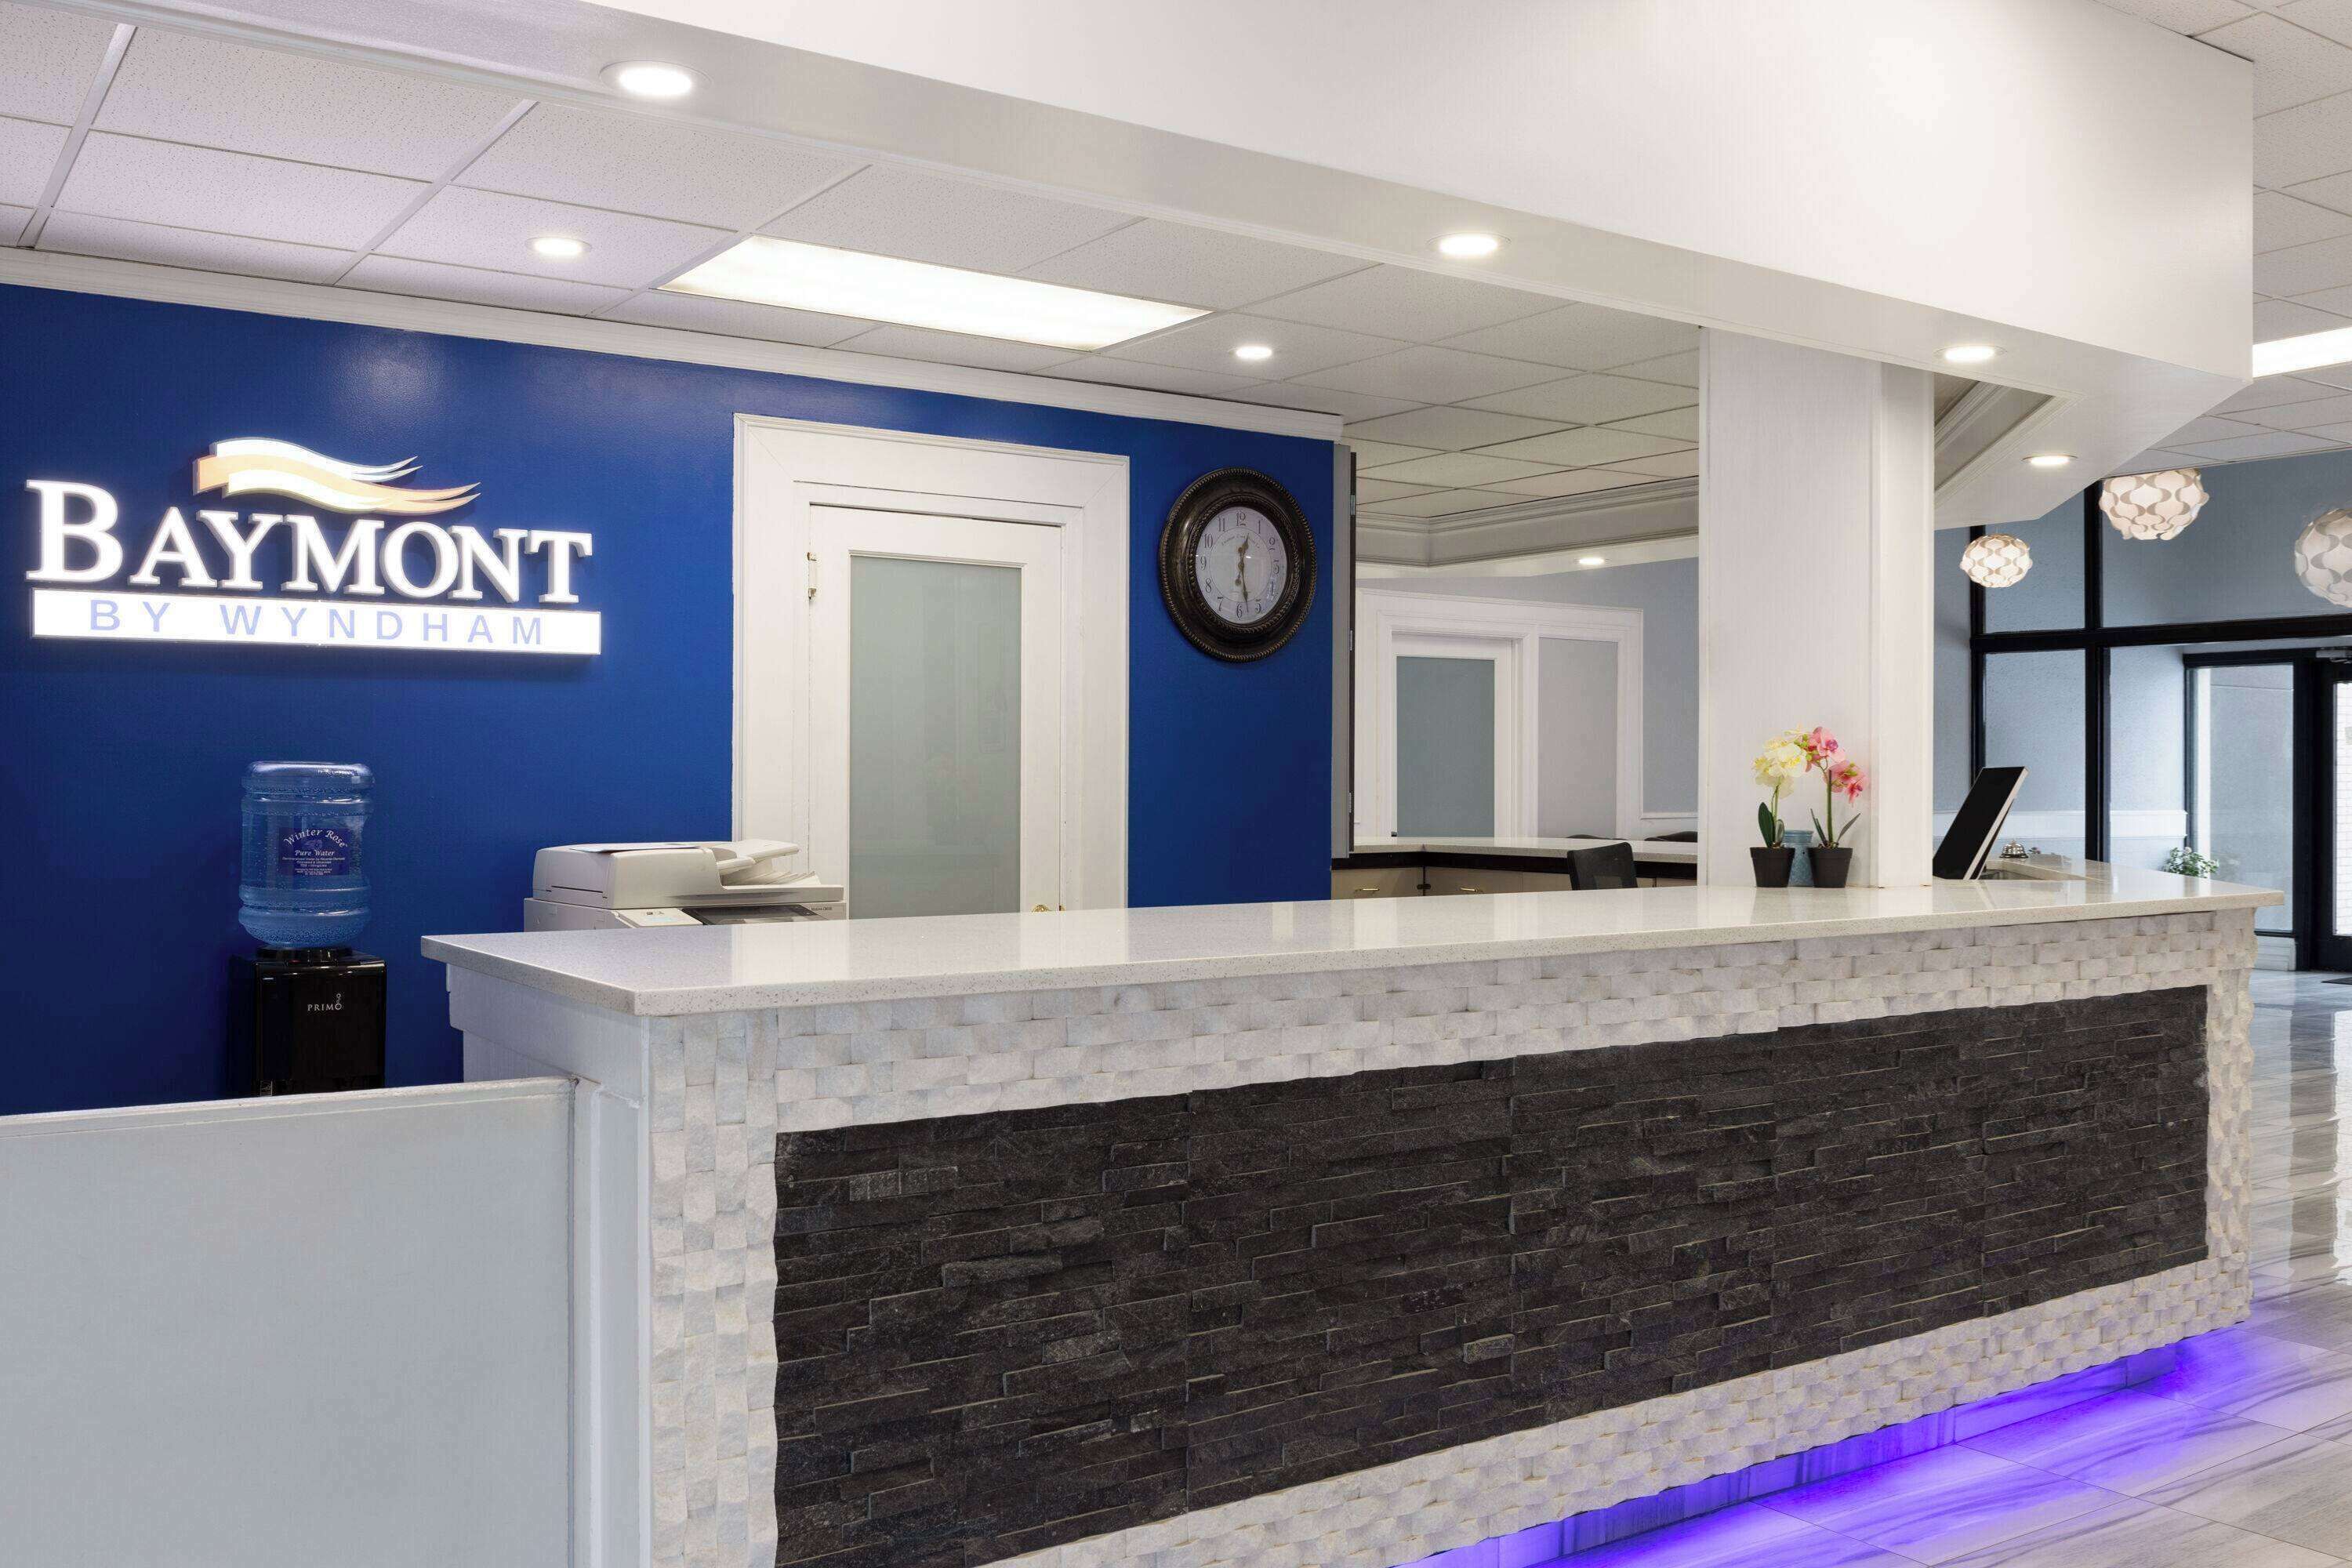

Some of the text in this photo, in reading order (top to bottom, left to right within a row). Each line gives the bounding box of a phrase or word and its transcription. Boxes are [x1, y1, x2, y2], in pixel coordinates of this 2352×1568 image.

[1218, 516, 1225, 532] 11
[1236, 511, 1246, 526] 12
[1257, 519, 1261, 534] 1
[24, 478, 593, 604] BAYMONT
[1204, 534, 1213, 549] 10
[1269, 537, 1276, 551] 2
[1200, 557, 1207, 571] 9
[1273, 559, 1280, 575] 3
[1205, 579, 1212, 593] 8
[1217, 596, 1224, 612] 7
[1236, 603, 1243, 619] 6
[1254, 598, 1261, 614] 5
[89, 599, 543, 646] BY WYNDHAM
[284, 829, 345, 848] Winter Rose
[307, 1003, 342, 1011] PRIMO
